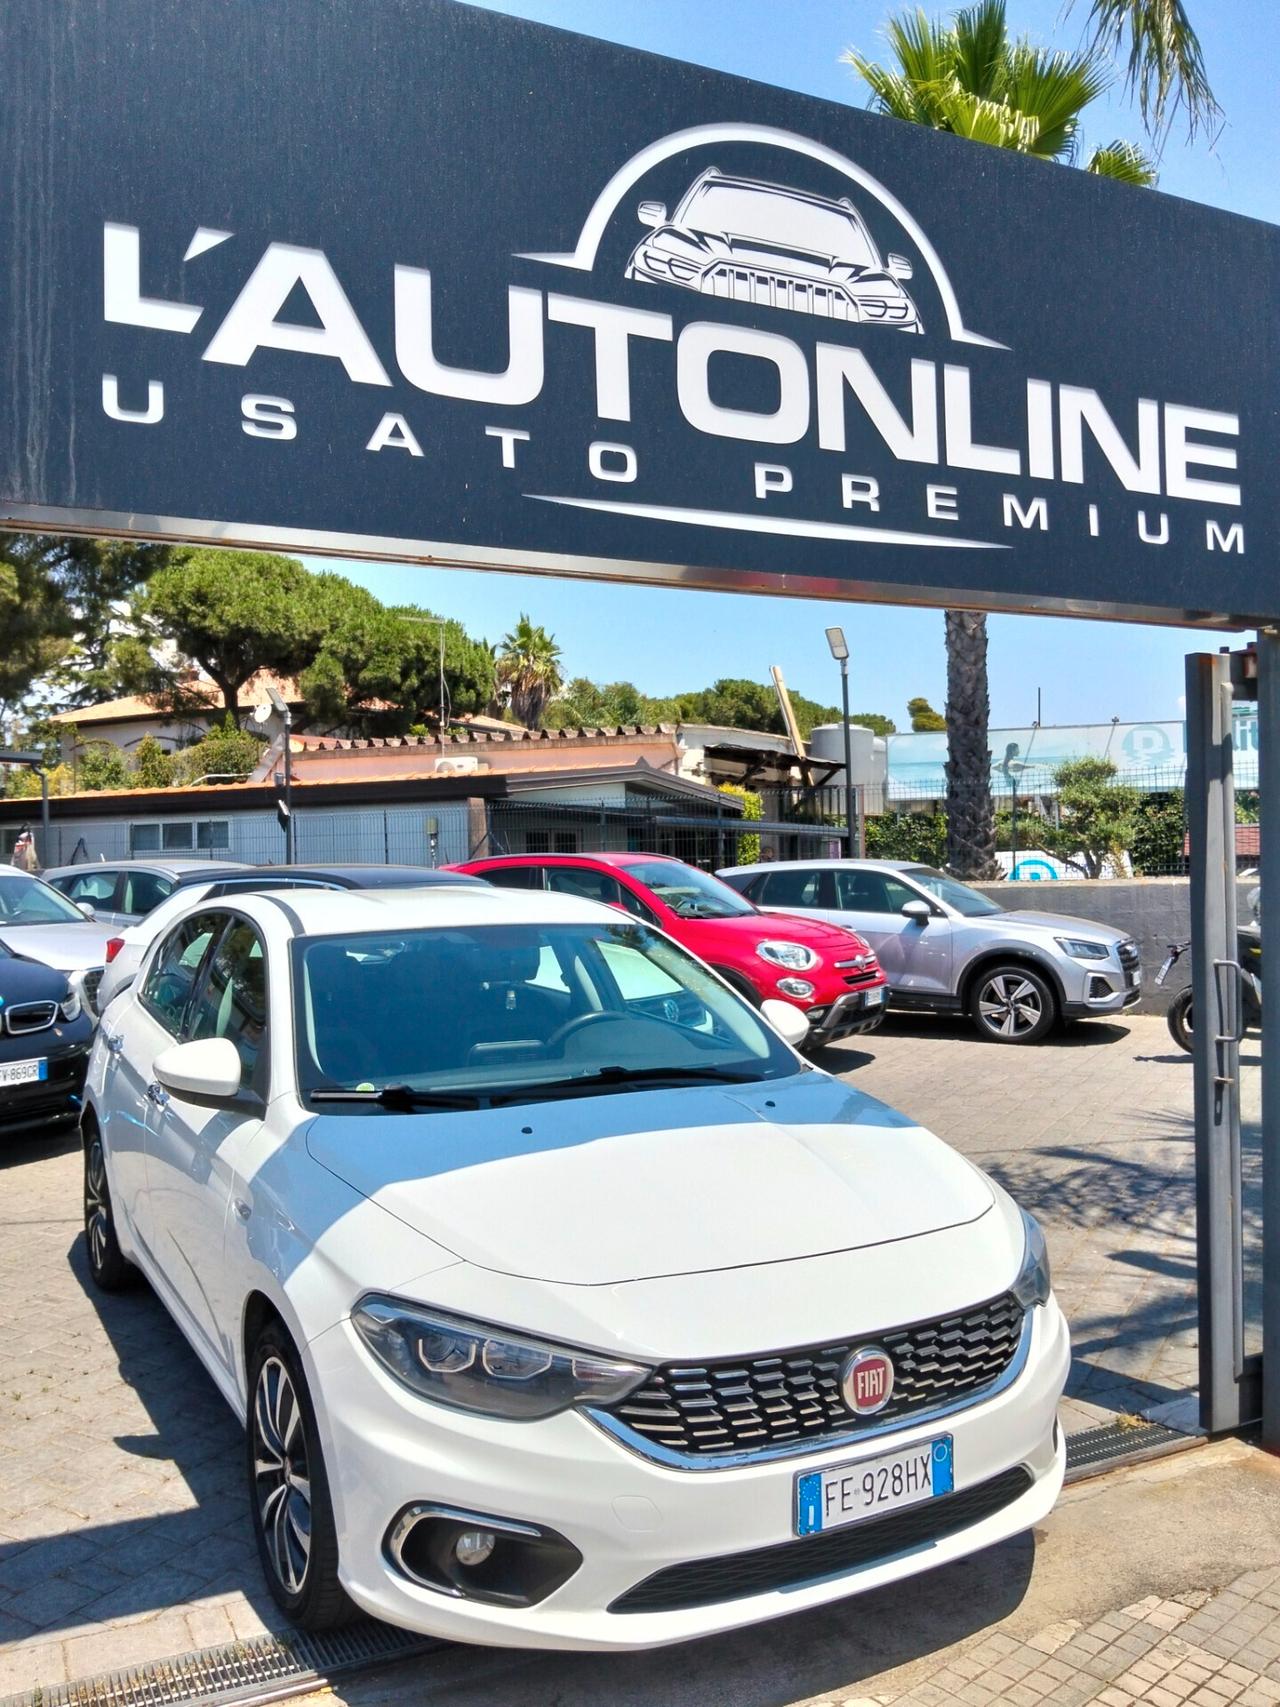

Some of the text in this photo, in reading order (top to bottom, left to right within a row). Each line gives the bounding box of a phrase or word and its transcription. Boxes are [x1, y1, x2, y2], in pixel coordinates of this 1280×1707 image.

[104, 222, 1241, 505] L'AUTONLINE
[102, 374, 1245, 554] USATO PREMIUM
[857, 1367, 885, 1399] FIAT
